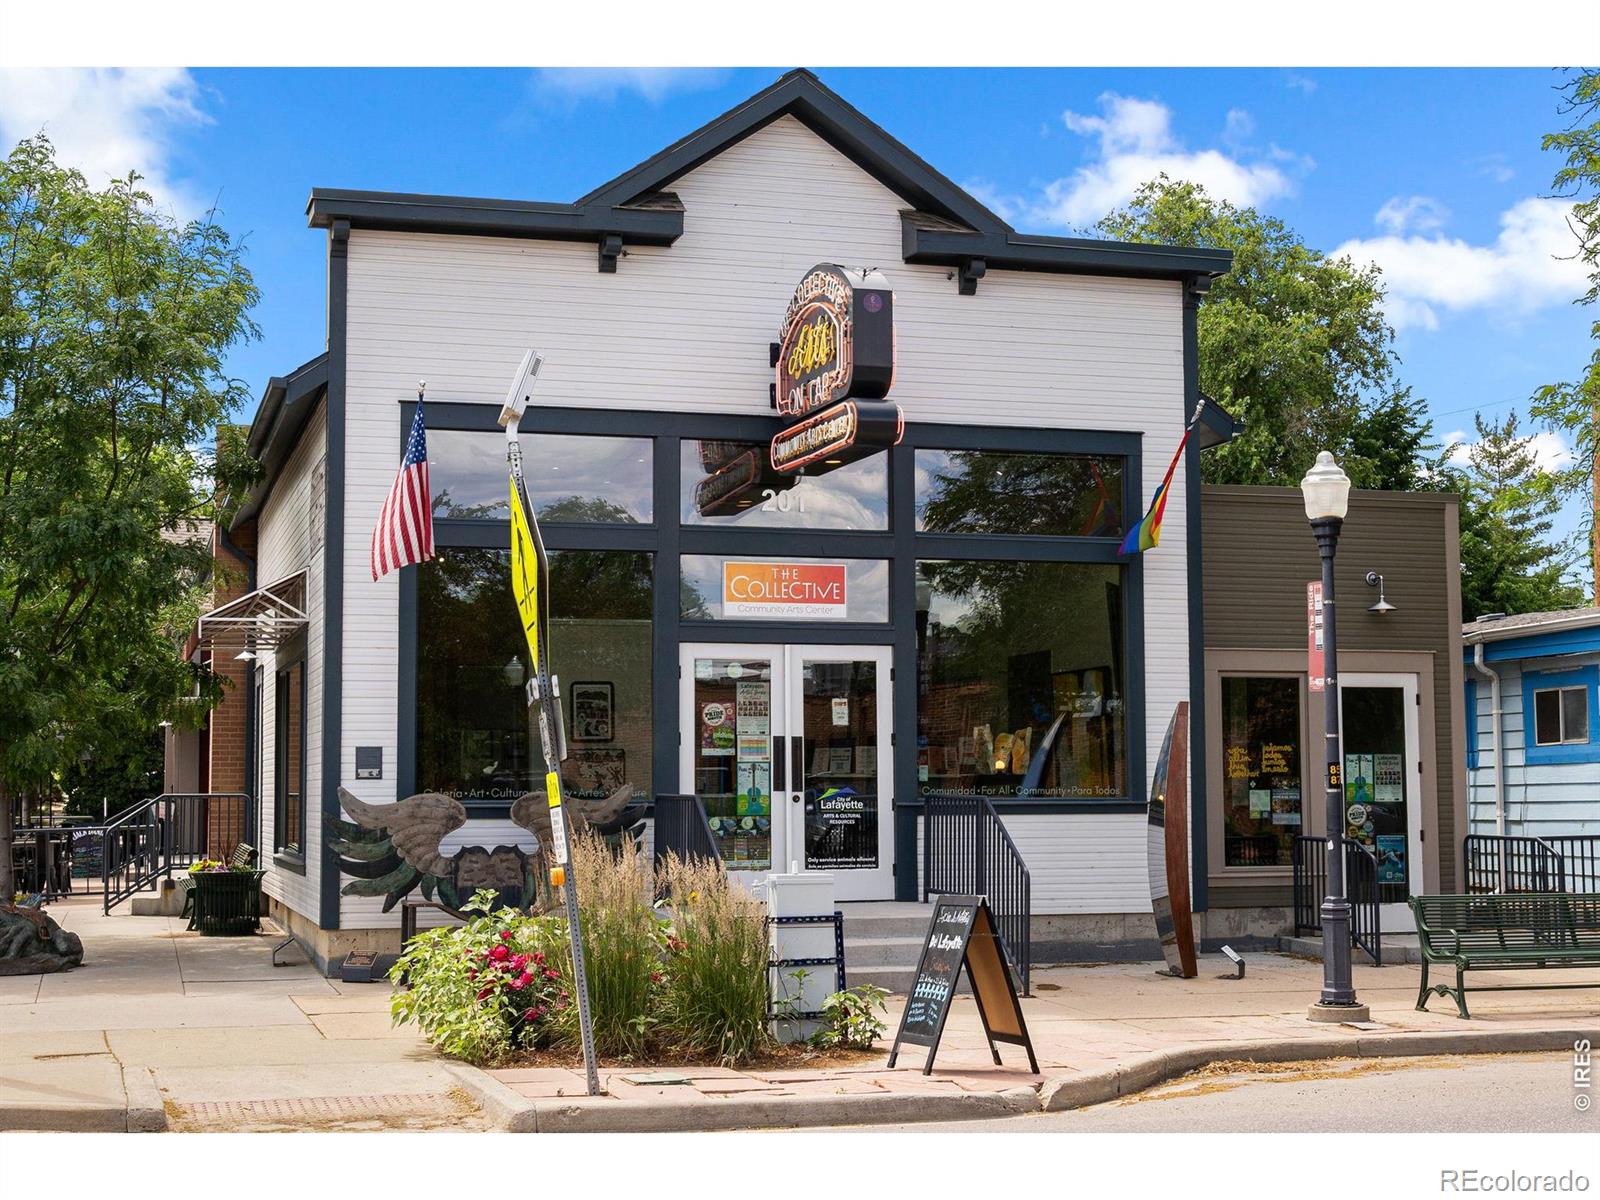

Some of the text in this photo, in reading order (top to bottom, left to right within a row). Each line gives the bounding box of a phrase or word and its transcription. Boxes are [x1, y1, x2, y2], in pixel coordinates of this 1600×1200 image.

[761, 489, 805, 512] 201
[771, 568, 798, 579] THE
[738, 604, 833, 615] Community Arts Center
[469, 788, 485, 798] Art
[578, 788, 605, 798] Artes
[922, 786, 1120, 798] Comunidad For All Community Para Todos
[820, 800, 864, 811] Lafayette
